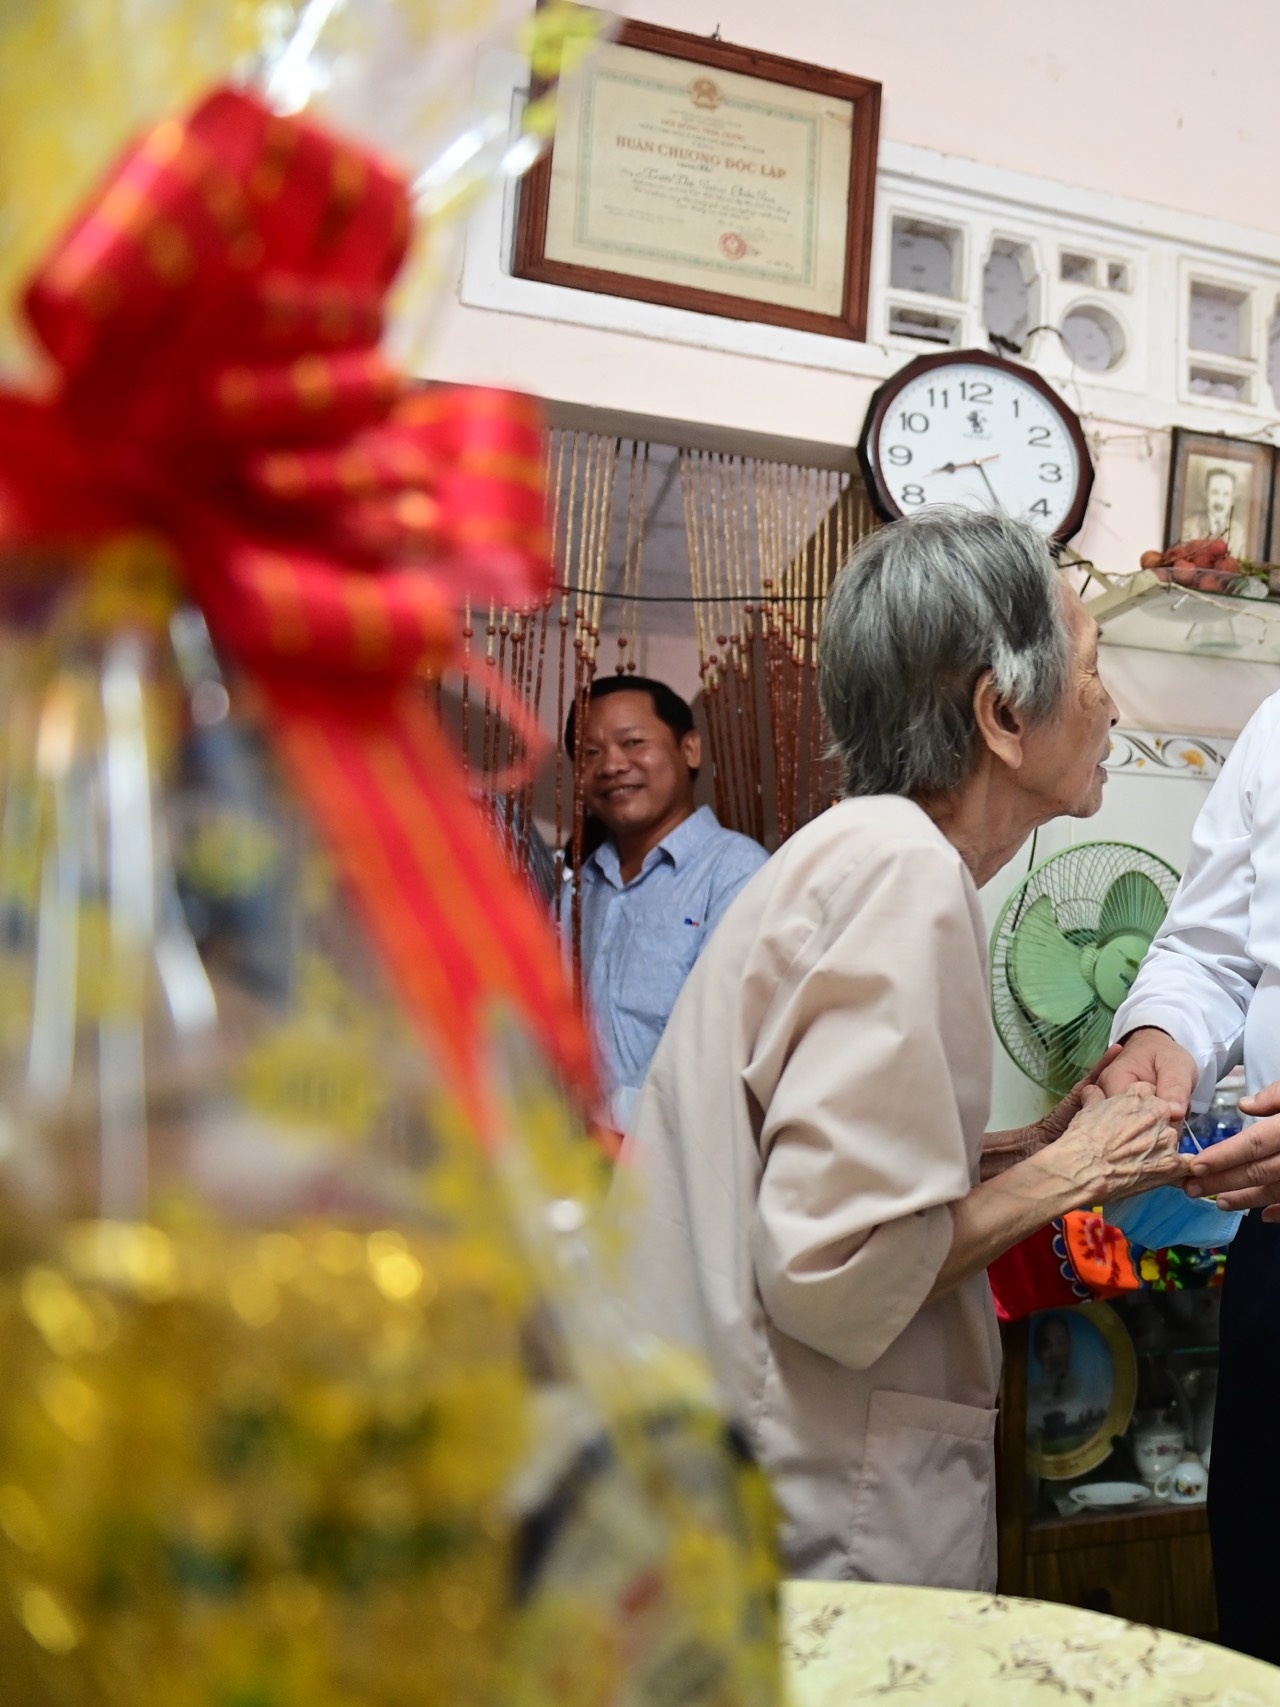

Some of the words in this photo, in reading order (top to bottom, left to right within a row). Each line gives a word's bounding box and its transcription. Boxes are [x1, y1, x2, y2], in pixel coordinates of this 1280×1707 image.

[928, 387, 949, 409] 11
[959, 381, 993, 405] 12
[1012, 398, 1020, 419] 1
[899, 411, 930, 434] 10
[1027, 425, 1052, 448] 2
[888, 444, 913, 467] 9
[1038, 462, 1062, 484] 3
[901, 483, 926, 506] 8
[1029, 497, 1052, 518] 4
